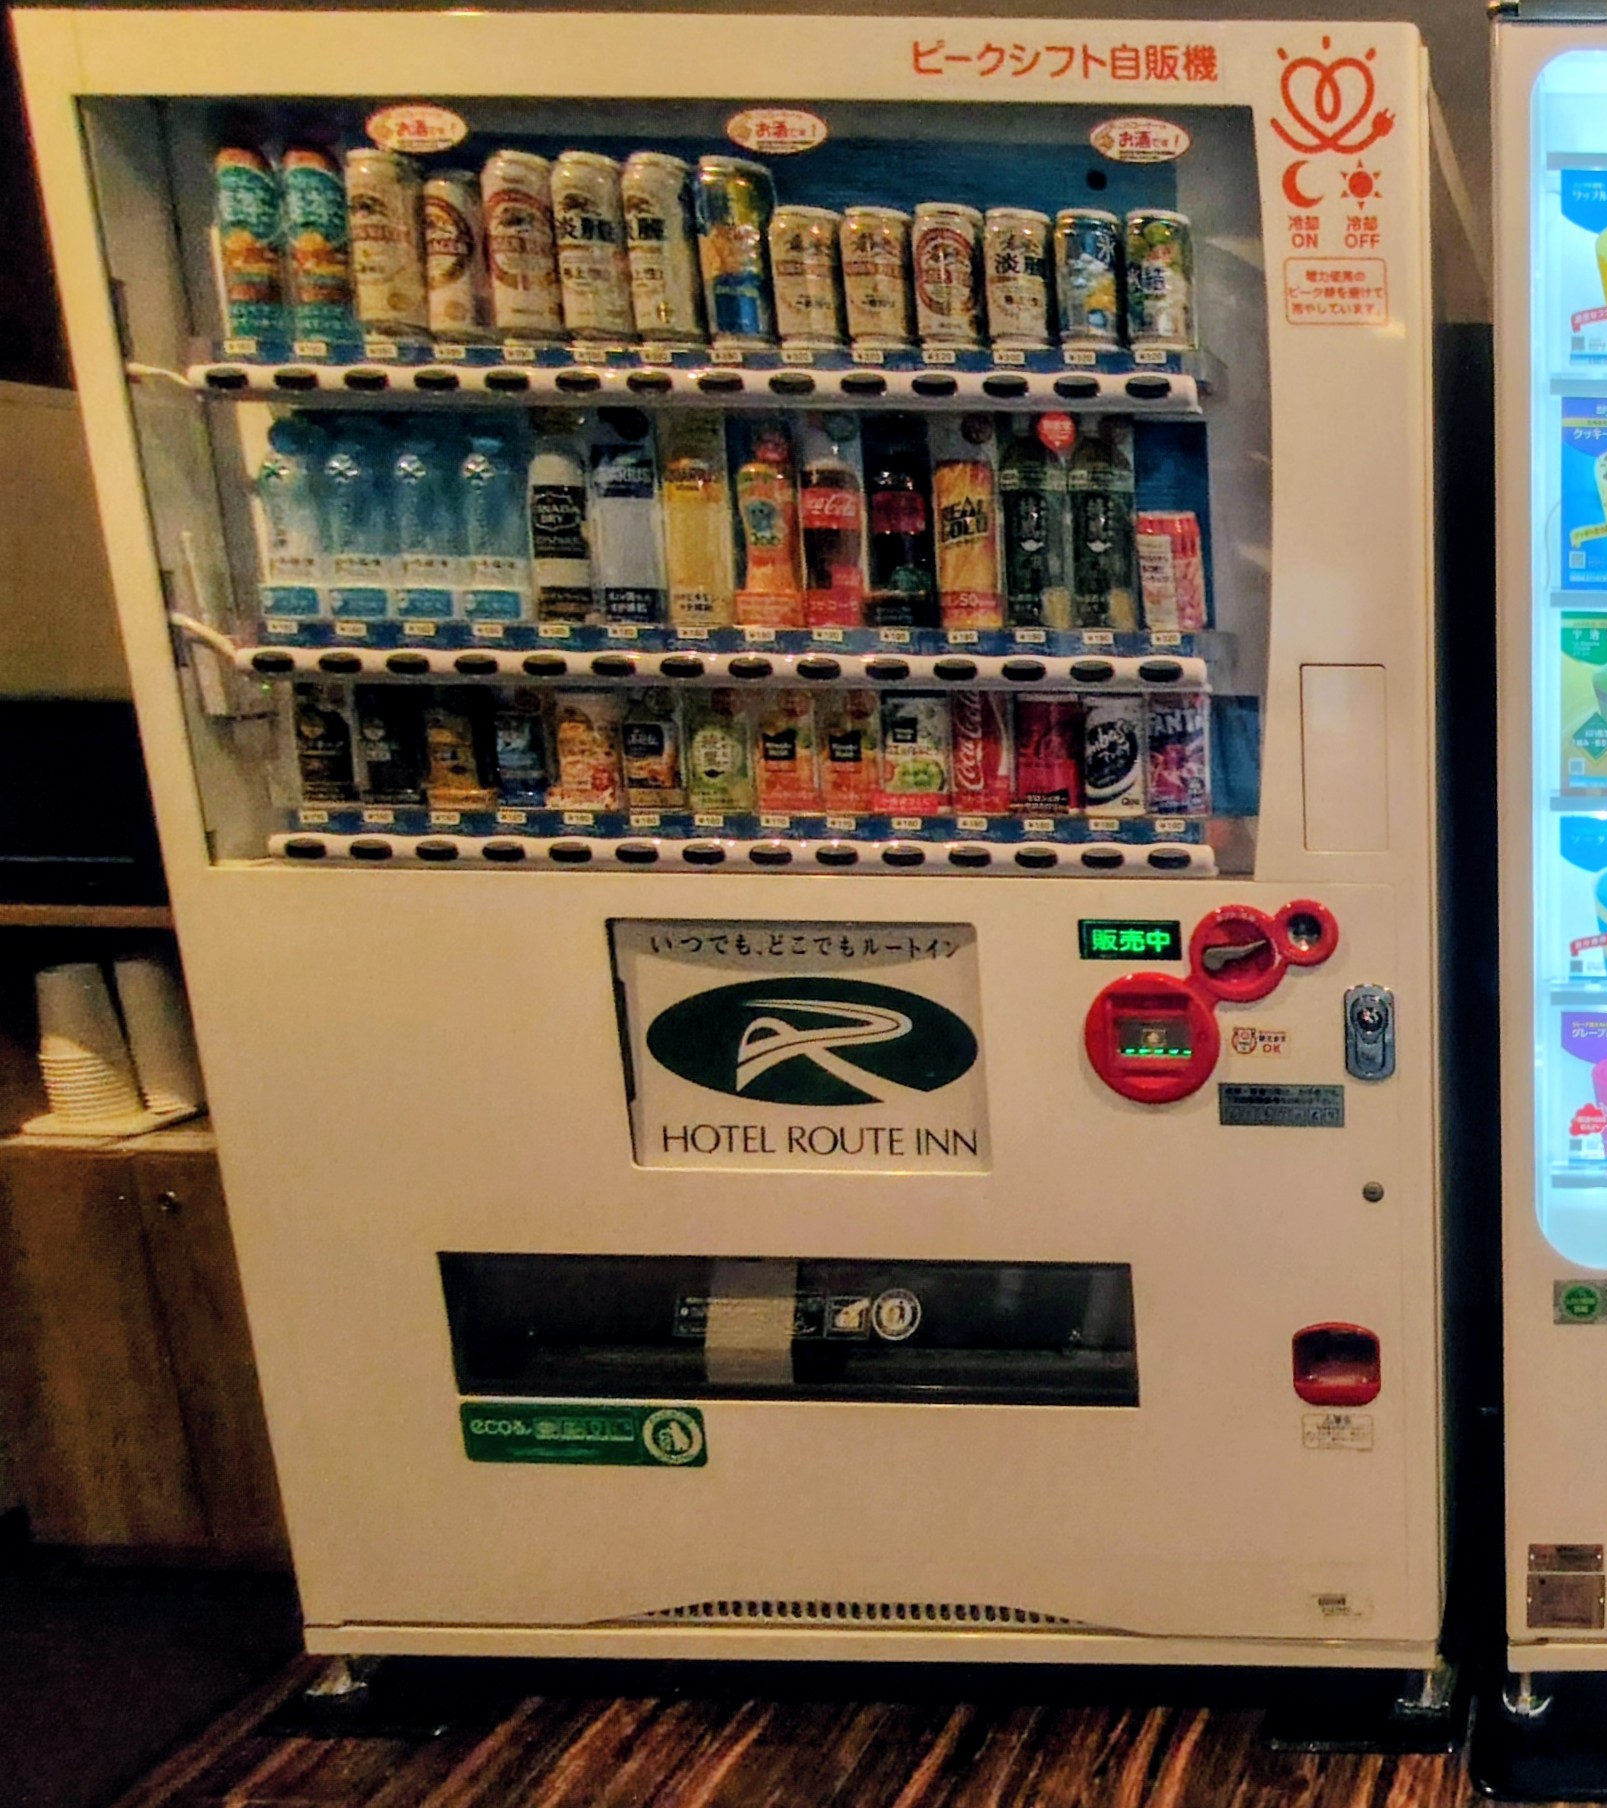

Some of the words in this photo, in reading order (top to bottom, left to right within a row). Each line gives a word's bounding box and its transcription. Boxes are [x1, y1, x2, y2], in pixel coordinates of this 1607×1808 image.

[912, 41, 1219, 82] ピークシフト自販機
[1288, 215, 1320, 231] 冷却
[1346, 215, 1378, 231] 冷却
[1291, 234, 1319, 248] ON
[1344, 234, 1381, 249] OFF
[650, 934, 960, 960] いつでも、どこでもルートイン
[1092, 929, 1171, 952] 販売中
[1262, 1044, 1282, 1053] OK
[663, 1124, 775, 1155] HOTEL
[788, 1125, 904, 1156] ROUTE
[916, 1128, 978, 1156] INN
